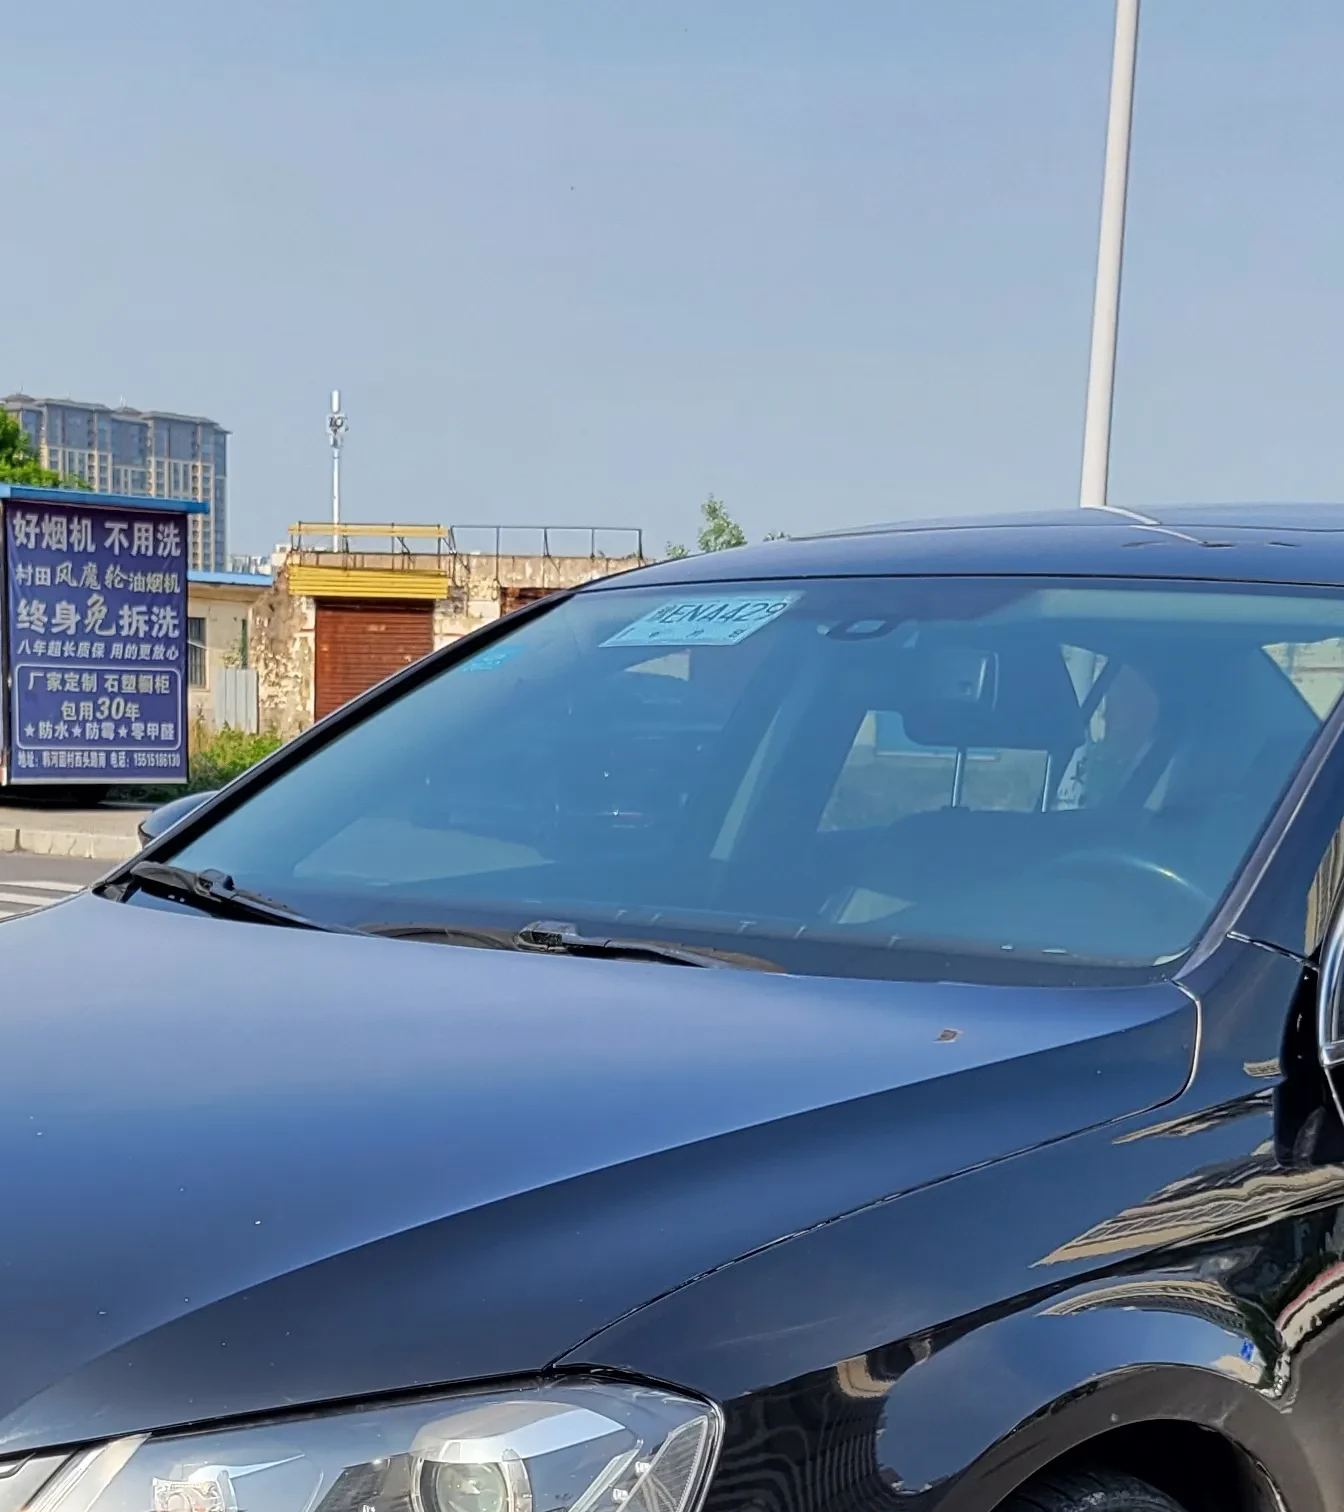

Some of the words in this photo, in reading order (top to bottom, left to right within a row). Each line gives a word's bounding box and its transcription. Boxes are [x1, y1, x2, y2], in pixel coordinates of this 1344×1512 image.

[13, 511, 96, 552] 好烟机
[104, 520, 181, 557] 不用洗
[16, 560, 180, 593] 村田风魔轮油烟机
[16, 593, 180, 638] 终身免拆洗
[17, 639, 105, 658] 八年超长质保
[110, 643, 179, 661] 用的更放心
[28, 671, 97, 693] 厂家定制
[104, 673, 170, 695] 石塑橱柜
[61, 697, 140, 722] 包用30年
